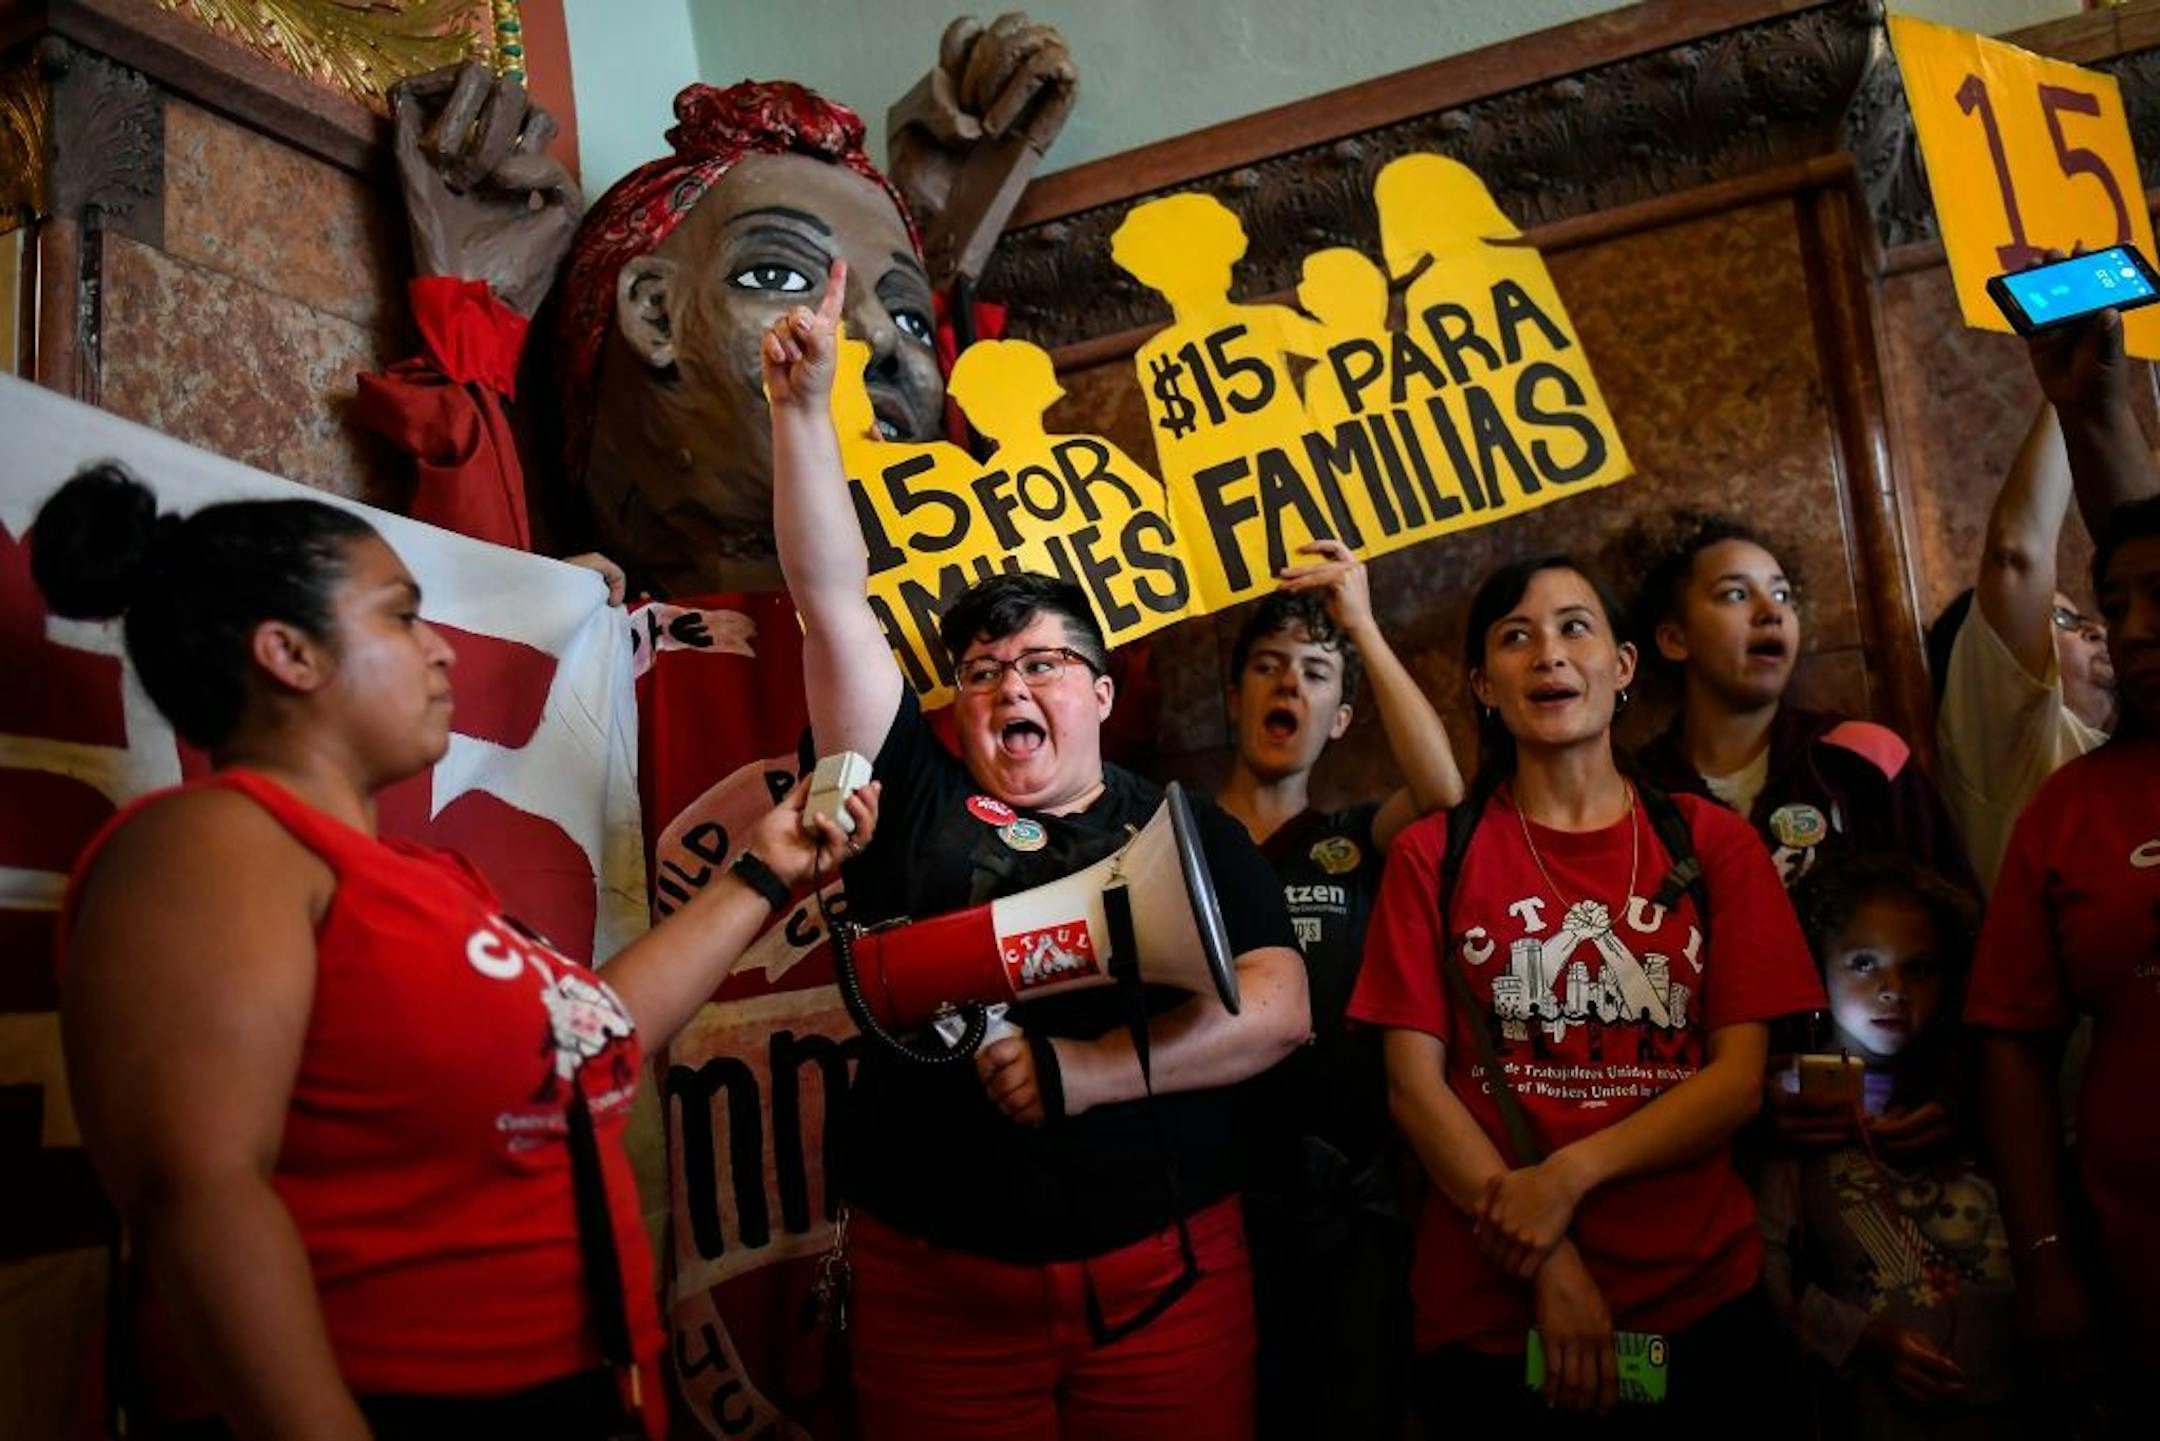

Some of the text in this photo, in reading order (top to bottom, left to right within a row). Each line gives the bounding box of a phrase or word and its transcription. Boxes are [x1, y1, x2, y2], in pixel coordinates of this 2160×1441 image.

[1149, 279, 1572, 439] $15 PARA
[970, 439, 1141, 551] FOR
[1193, 361, 1608, 594] FAMILIAS
